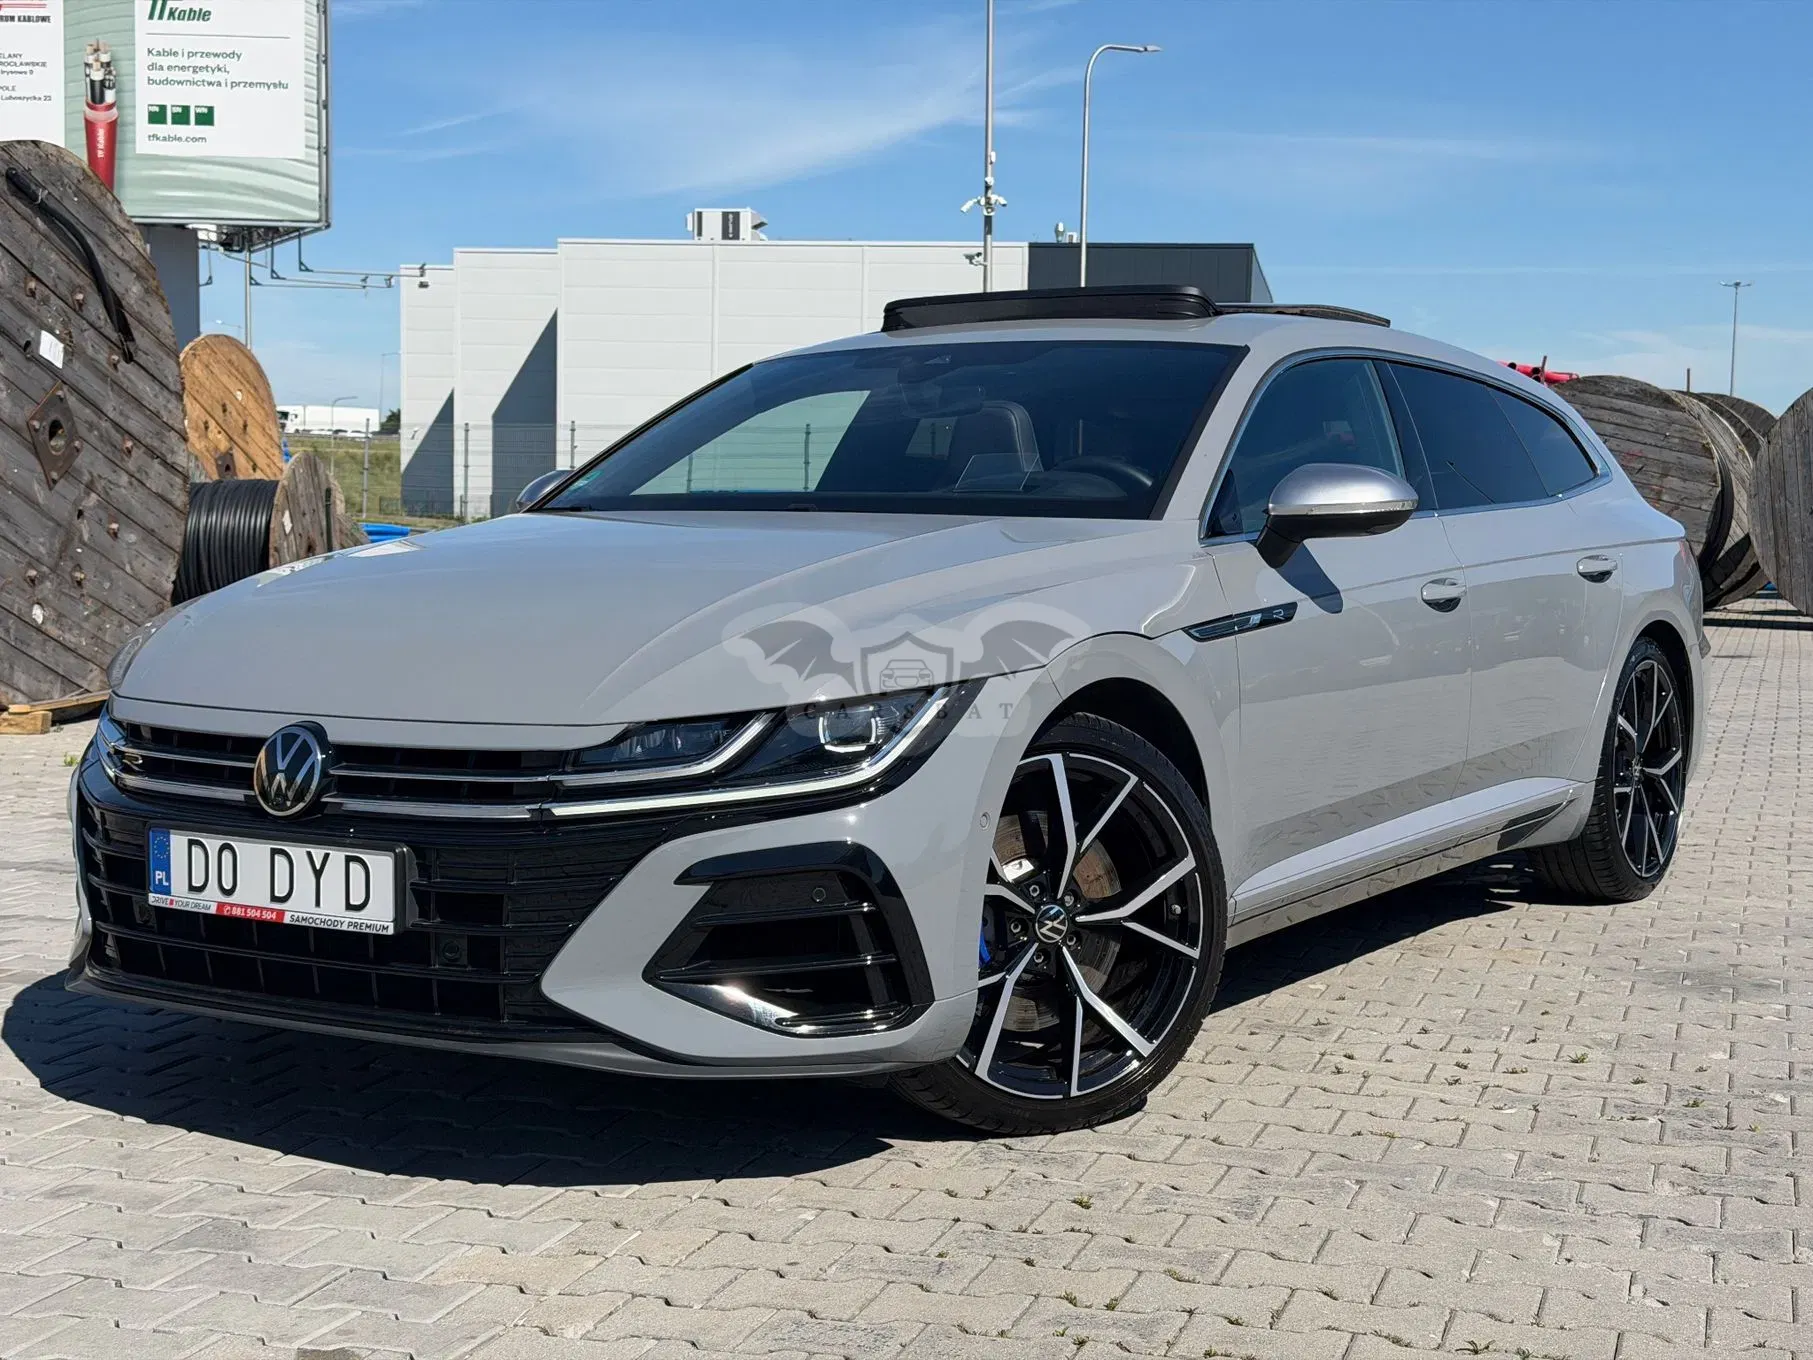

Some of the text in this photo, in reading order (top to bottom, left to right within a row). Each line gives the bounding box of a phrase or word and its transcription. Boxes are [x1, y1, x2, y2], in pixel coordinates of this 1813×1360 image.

[167, 7, 212, 22] Kable
[147, 48, 179, 58] Kable
[187, 50, 242, 61] przewody
[147, 62, 230, 74] dla energetyki,
[147, 76, 222, 88] budownictwa
[230, 80, 289, 91] przemysłu
[148, 133, 207, 143] tfkable.com
[155, 870, 169, 886] PL
[269, 847, 371, 912] DYD
[174, 899, 190, 908] YOUR
[190, 901, 211, 911] DREAM
[231, 906, 277, 919] 881 504 504
[289, 914, 390, 933] SAMOCHODY PREMIUM
